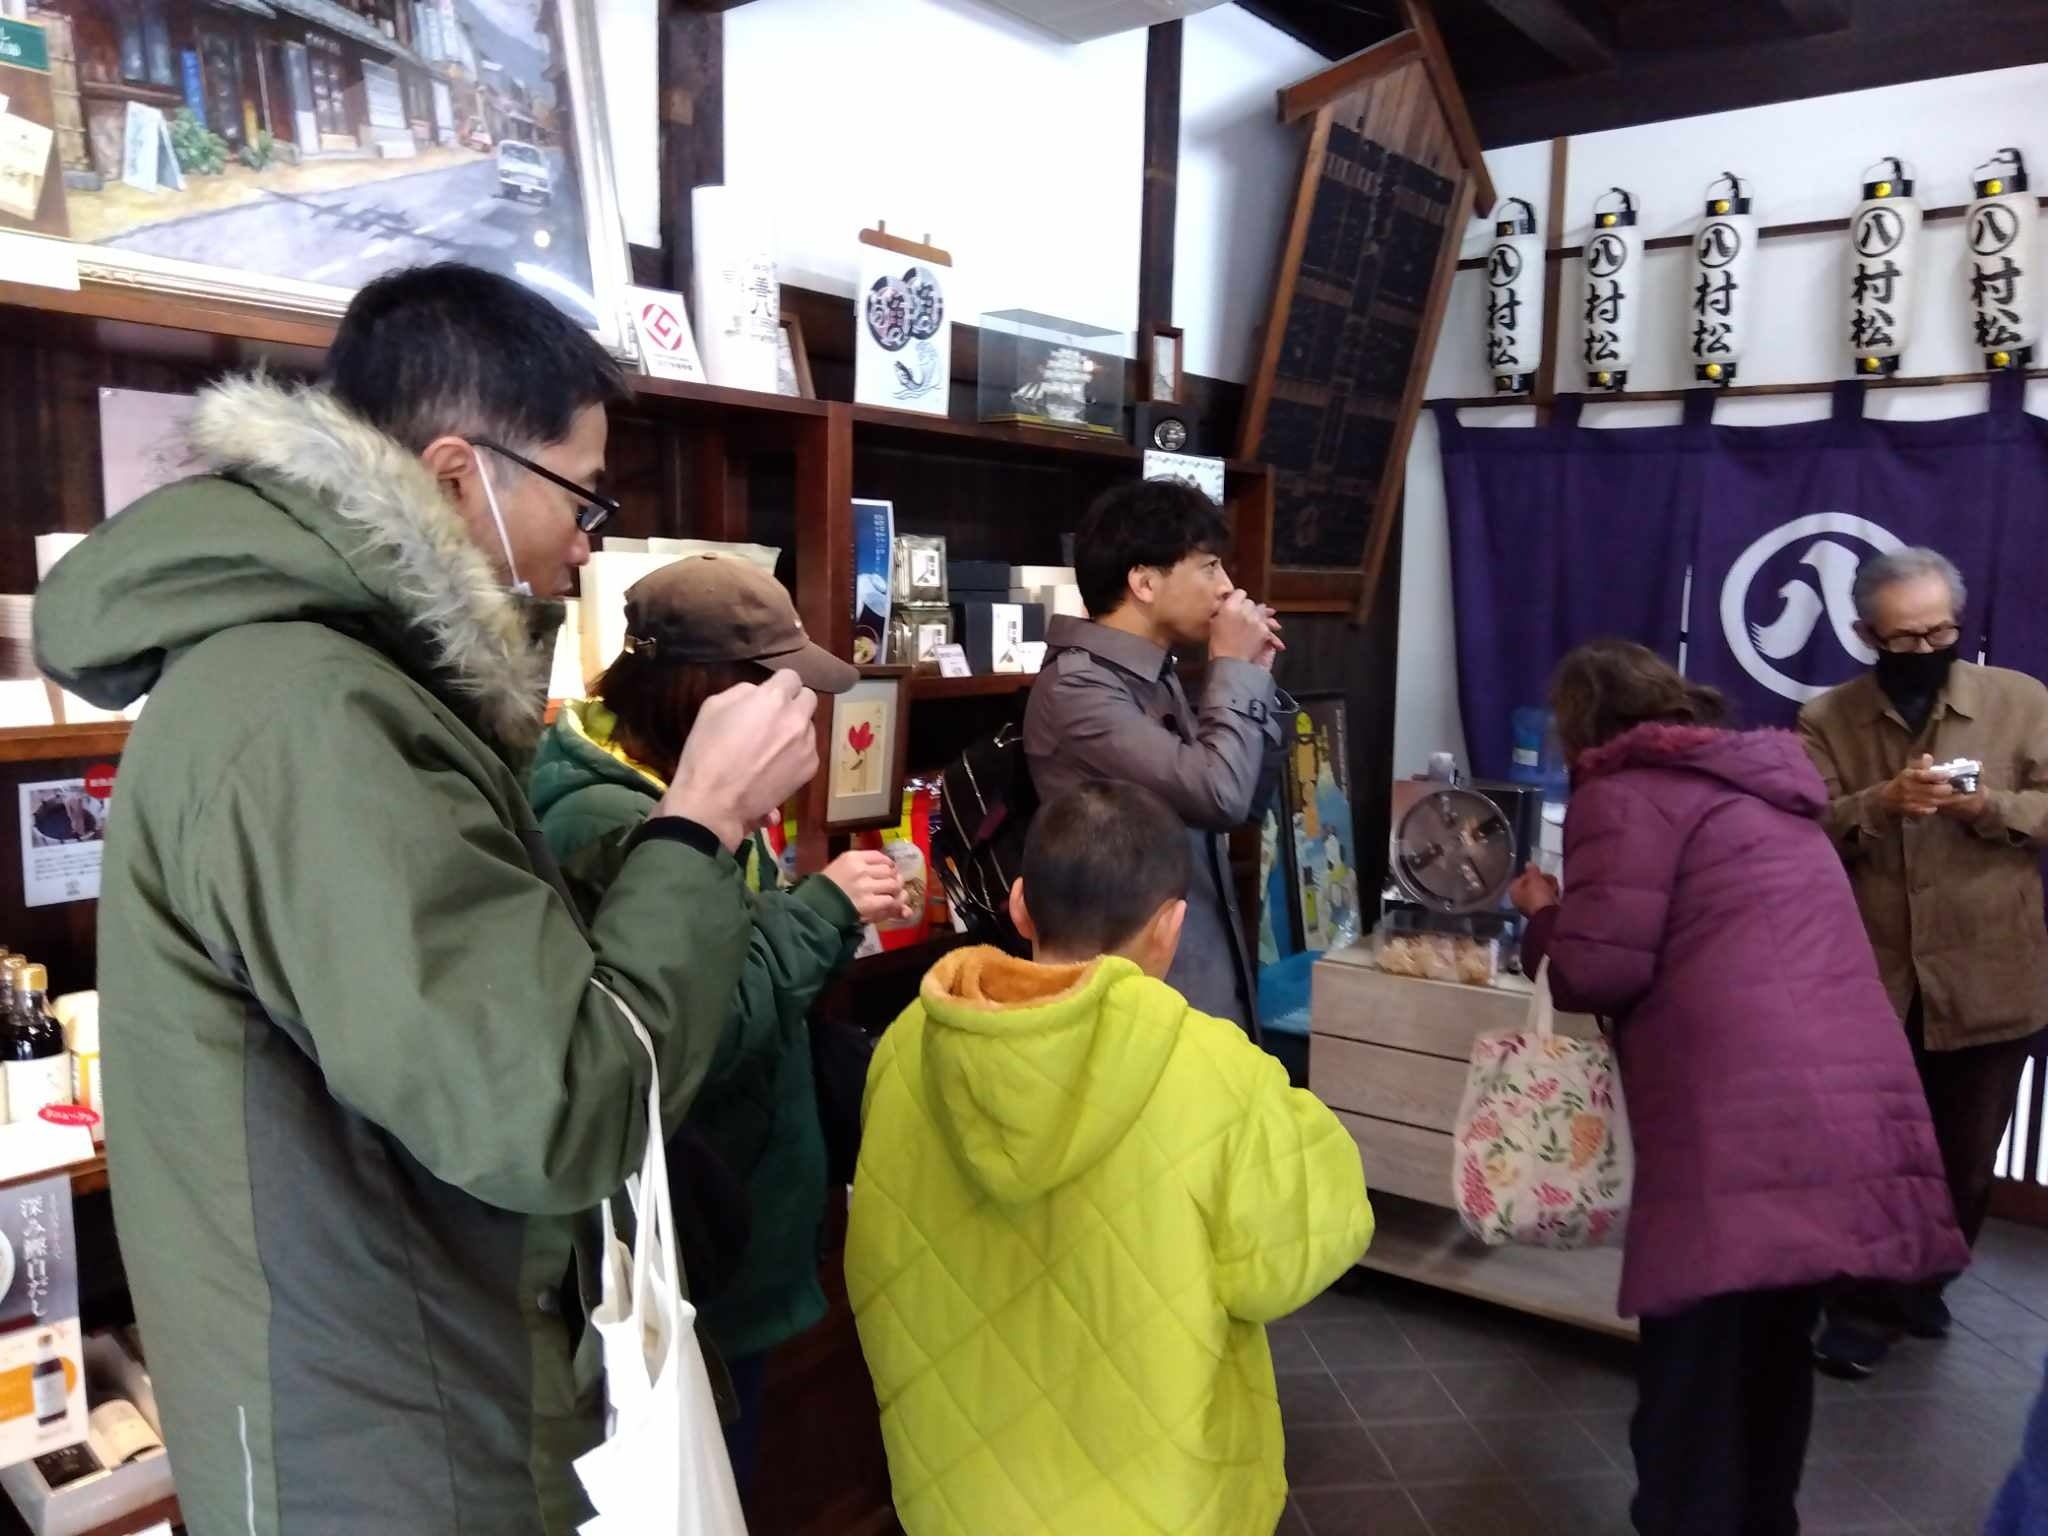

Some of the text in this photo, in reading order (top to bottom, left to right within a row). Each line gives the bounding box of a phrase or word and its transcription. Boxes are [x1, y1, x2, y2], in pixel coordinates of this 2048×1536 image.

[1487, 287, 1521, 369] 村松
[1584, 279, 1625, 364] 村松
[1693, 270, 1738, 357] 村松
[1850, 260, 1902, 348] 村松
[1971, 257, 2023, 347] 村松
